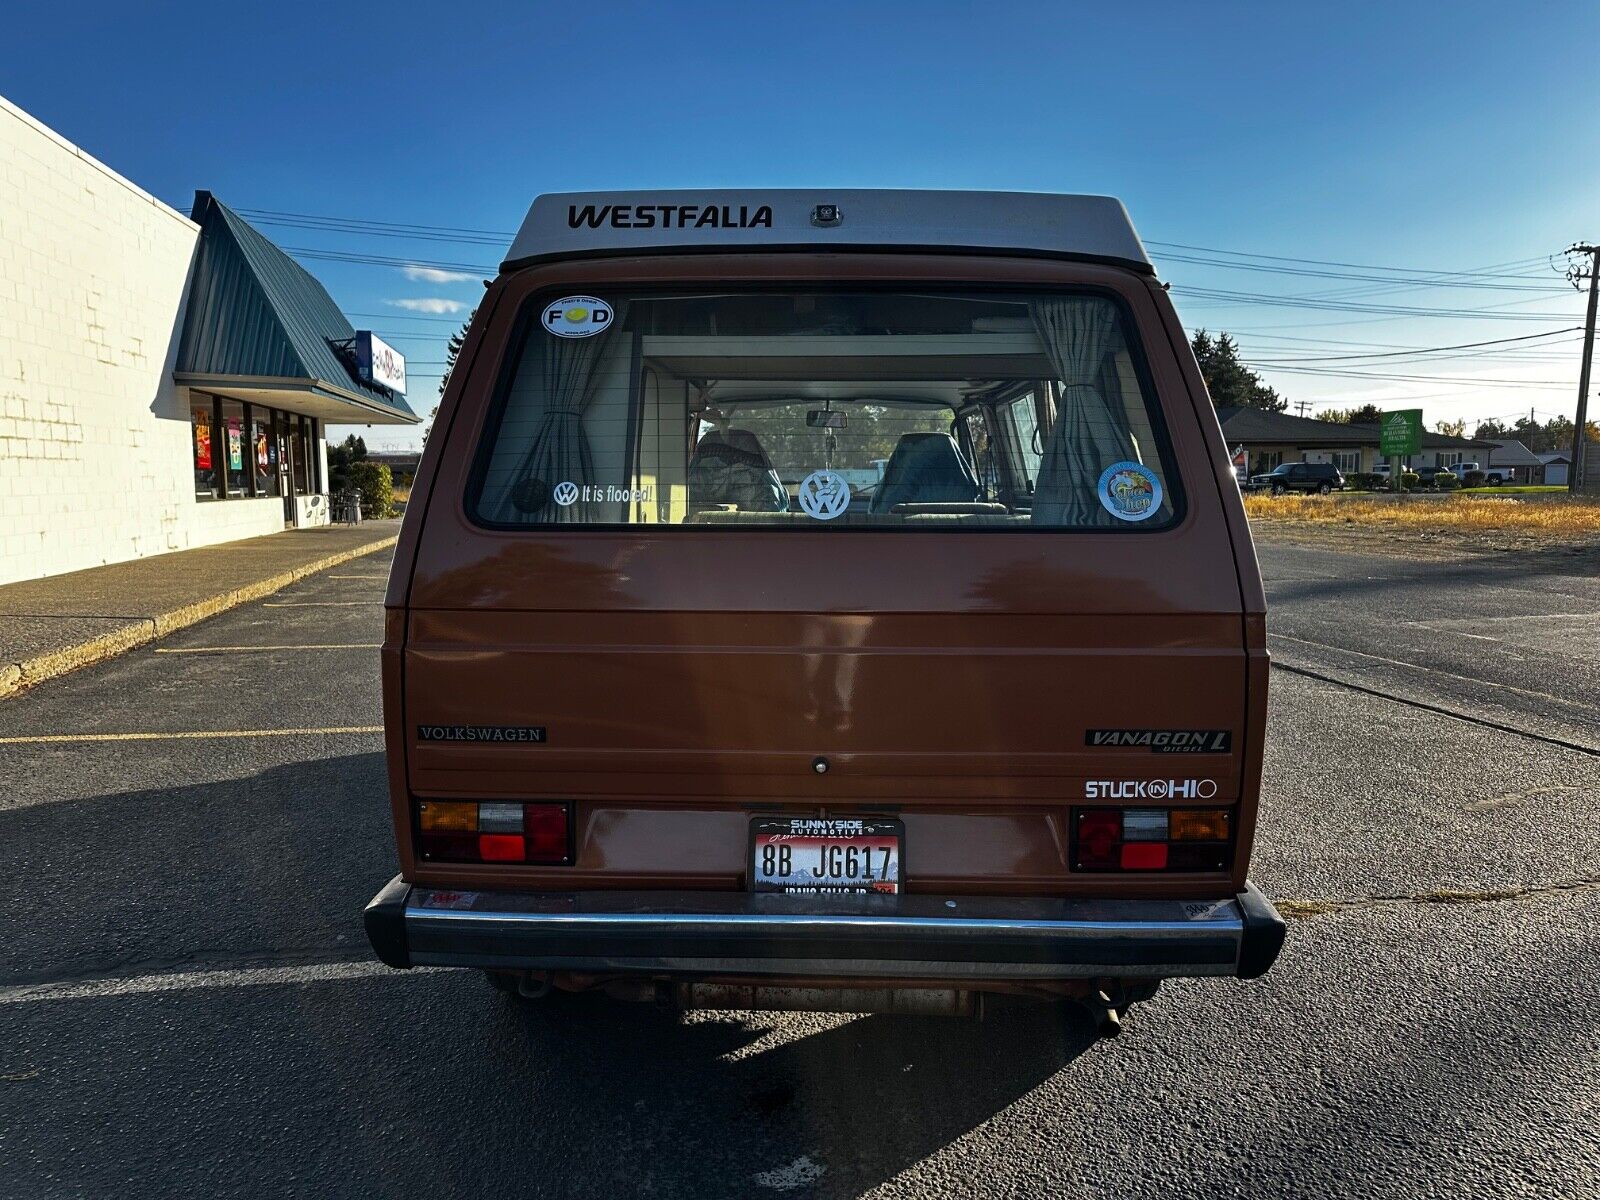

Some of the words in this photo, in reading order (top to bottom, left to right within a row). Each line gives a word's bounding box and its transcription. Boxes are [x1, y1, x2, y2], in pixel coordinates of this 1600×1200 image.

[568, 205, 773, 228] WESTFALIA
[582, 485, 591, 502] It
[593, 485, 604, 502] is
[606, 485, 653, 502] floored!
[420, 727, 541, 741] VOLKSWAGEN
[1093, 731, 1209, 745] VANAGON
[1210, 731, 1226, 750] L
[1085, 780, 1148, 798] STUCK
[790, 819, 864, 830] SUNNYSIDE
[762, 844, 792, 878] 8B
[812, 845, 892, 880] JG617
